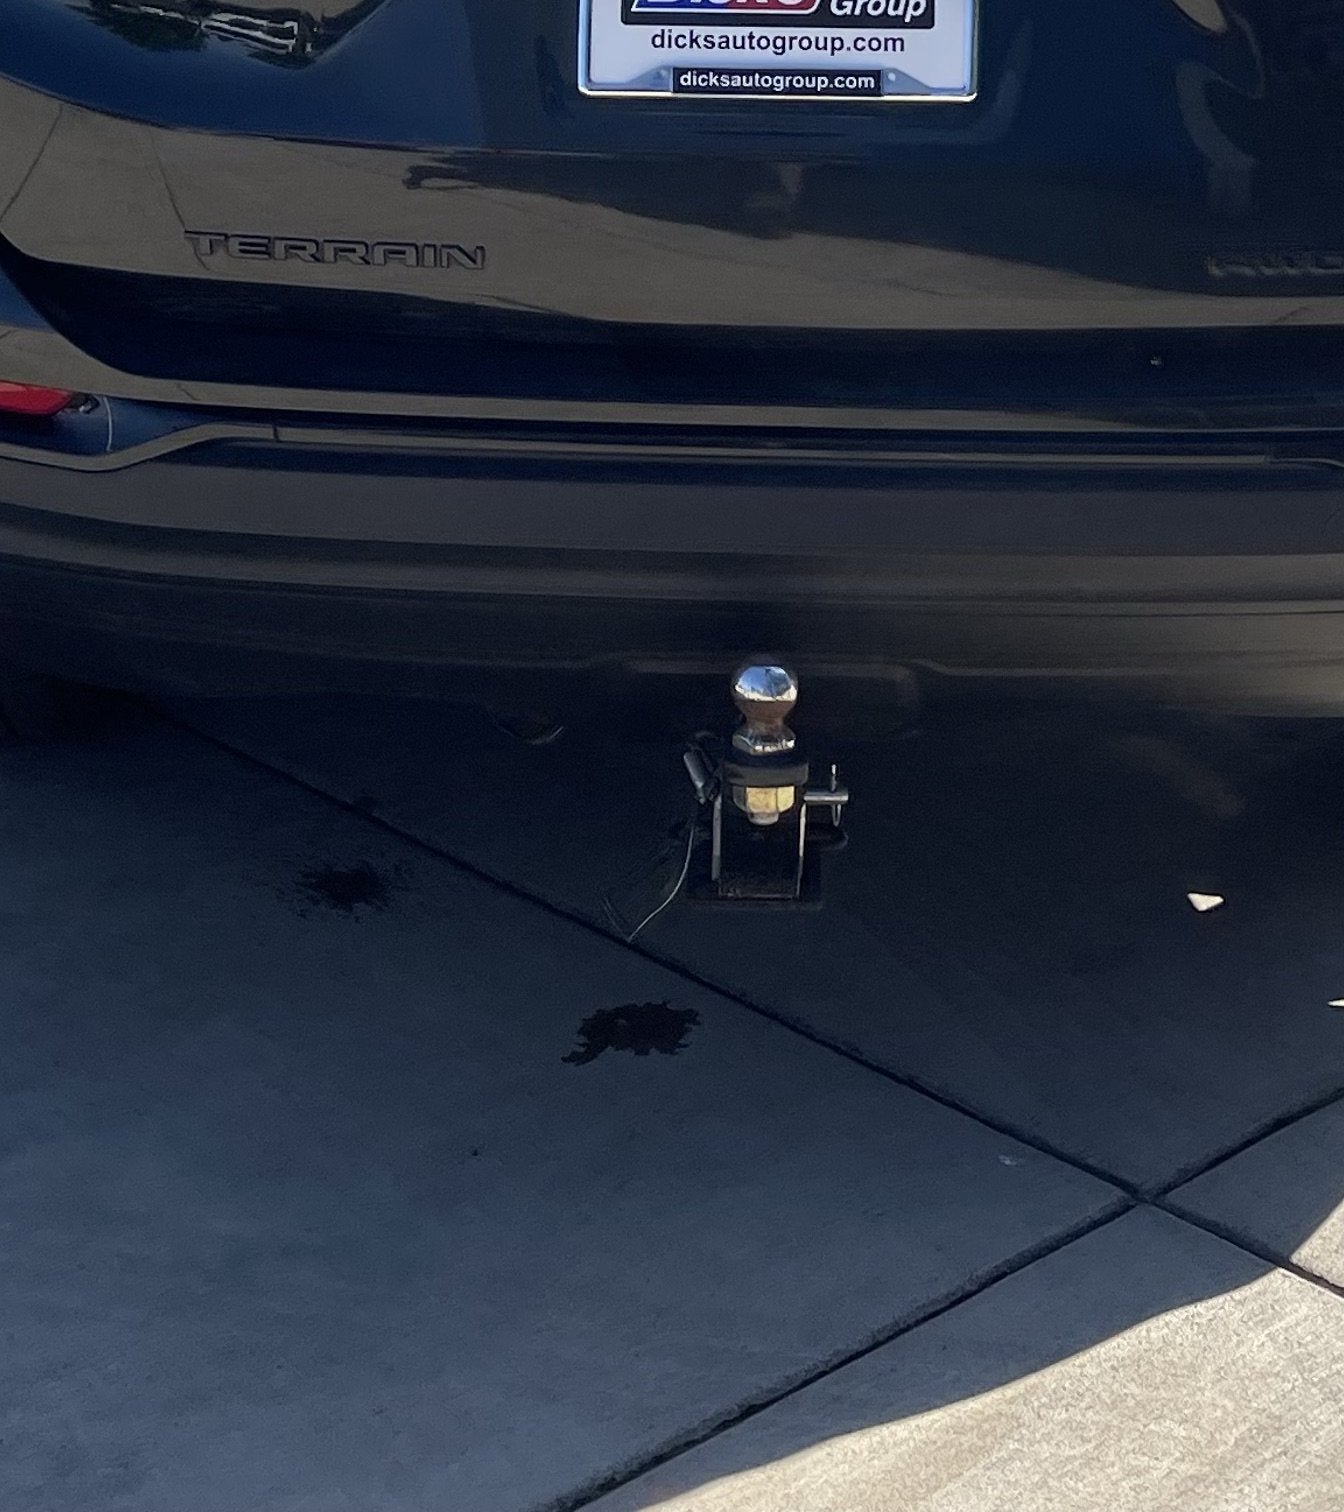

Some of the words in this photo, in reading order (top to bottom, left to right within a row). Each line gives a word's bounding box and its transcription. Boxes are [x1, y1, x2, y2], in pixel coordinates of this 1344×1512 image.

[651, 29, 905, 56] dicksautogroup.com
[679, 70, 876, 92] dicksautogroup.com
[184, 230, 485, 270] TERRAIN
